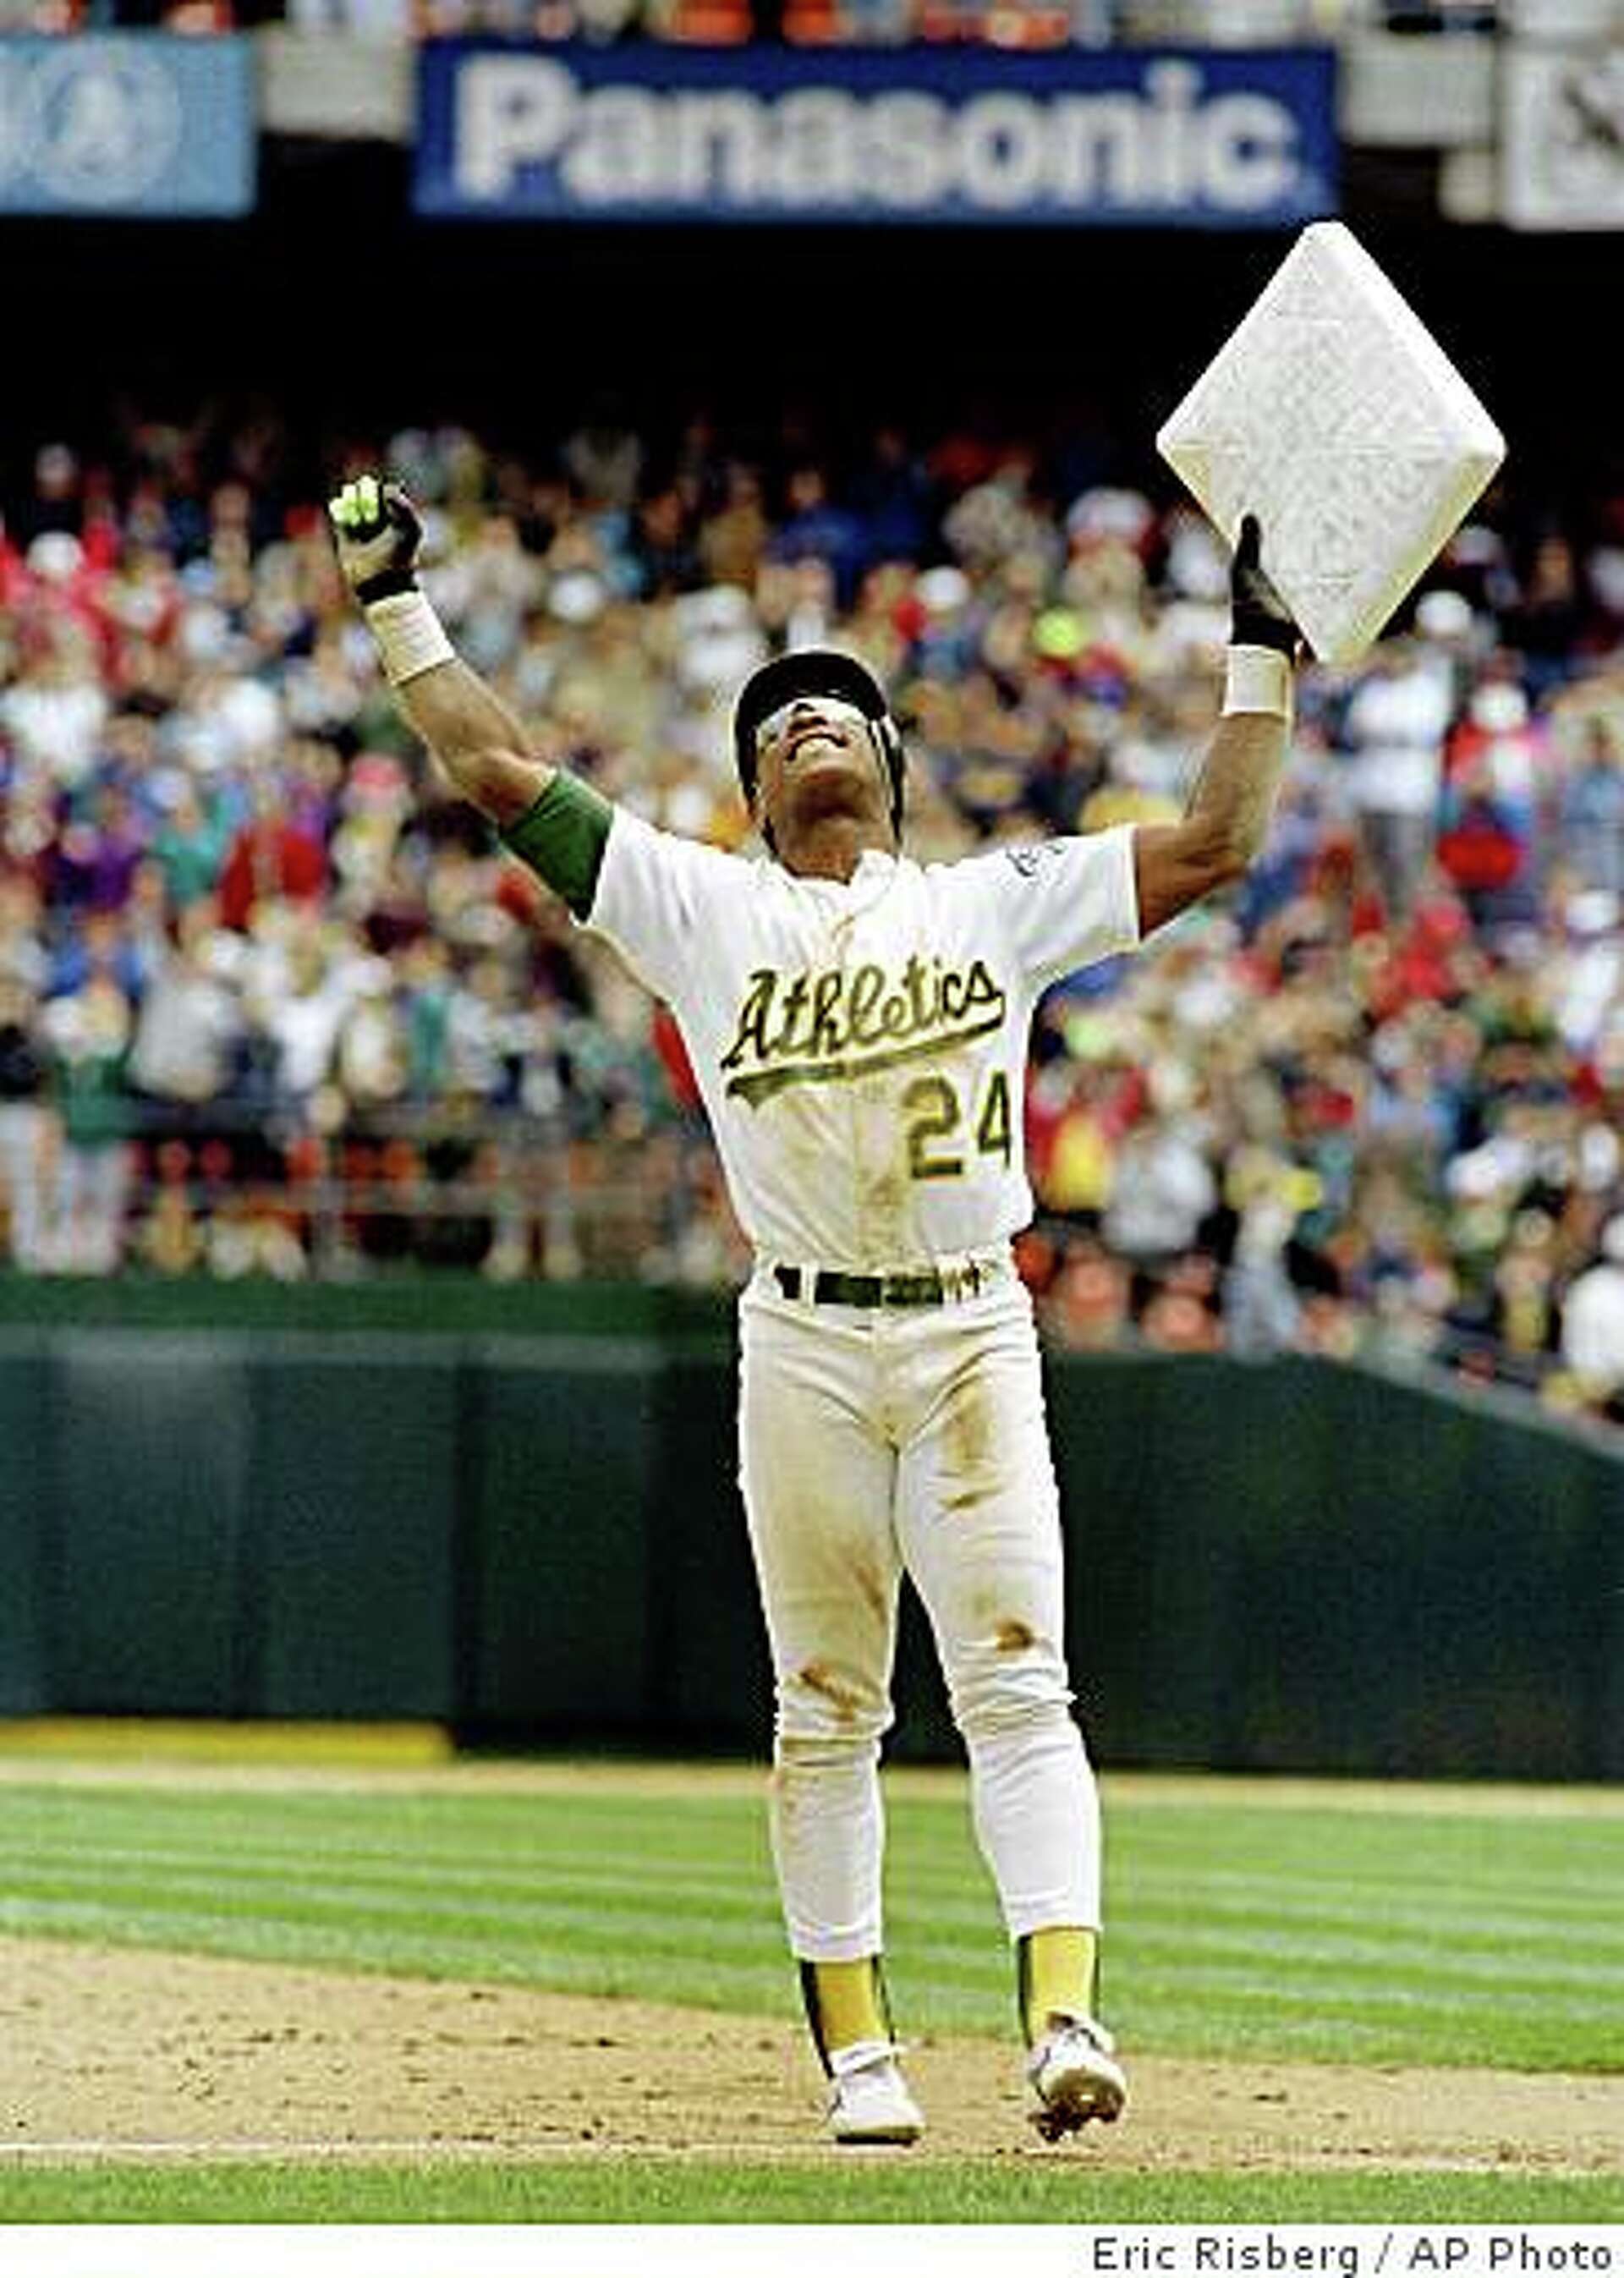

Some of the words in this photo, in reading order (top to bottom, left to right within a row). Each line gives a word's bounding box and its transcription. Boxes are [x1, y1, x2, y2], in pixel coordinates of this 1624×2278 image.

[455, 52, 1300, 210] Panasonic
[721, 955, 1007, 1068] Athletics
[902, 1069, 1012, 1179] 24
